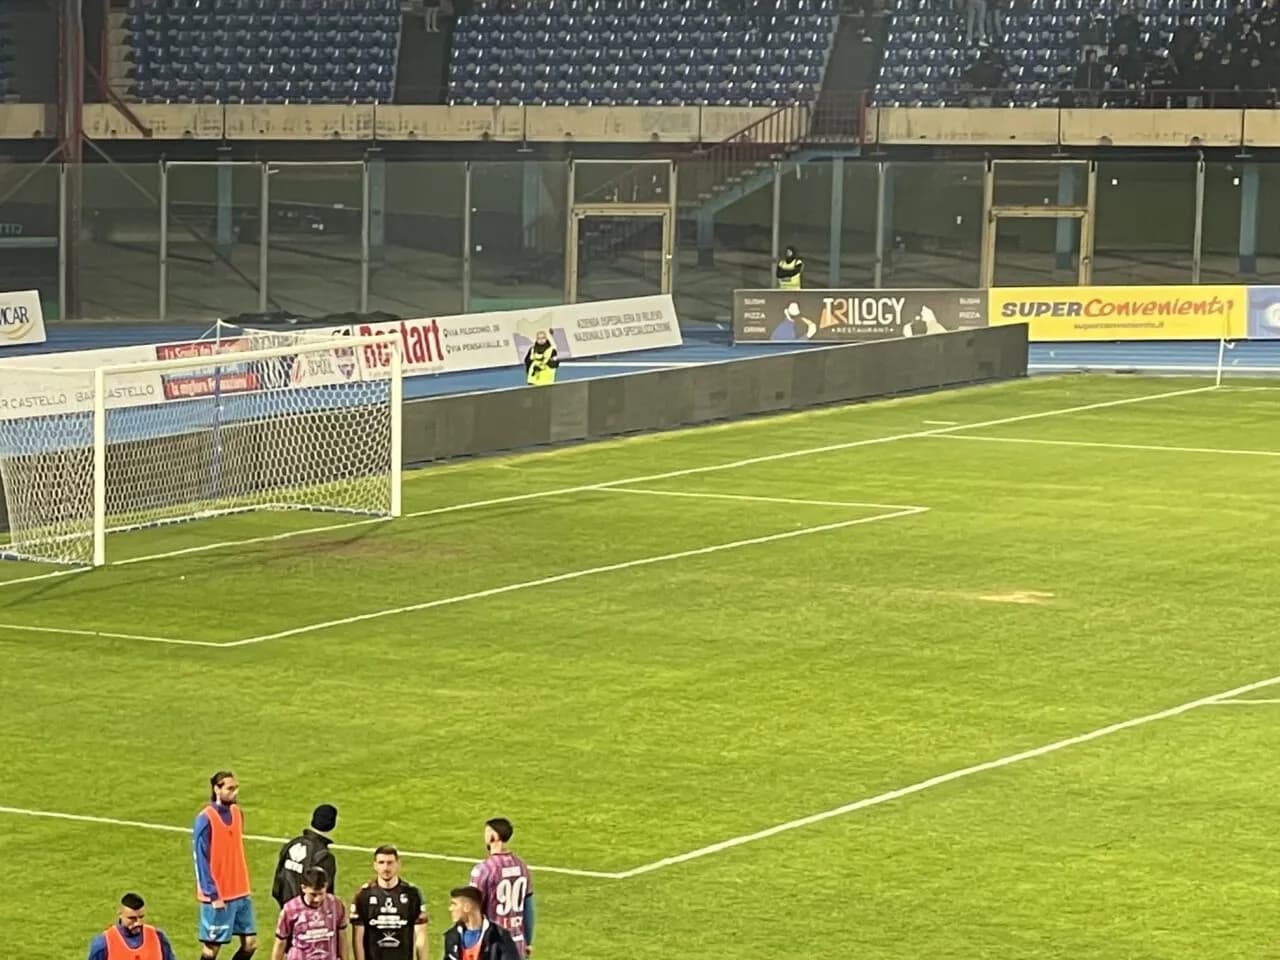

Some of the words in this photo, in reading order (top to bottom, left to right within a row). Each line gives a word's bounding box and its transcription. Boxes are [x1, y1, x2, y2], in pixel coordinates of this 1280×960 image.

[822, 297, 905, 326] TRILOGY
[11, 394, 67, 409] CASTELLO
[104, 384, 155, 400] ASTELLO
[496, 876, 528, 916] 90
